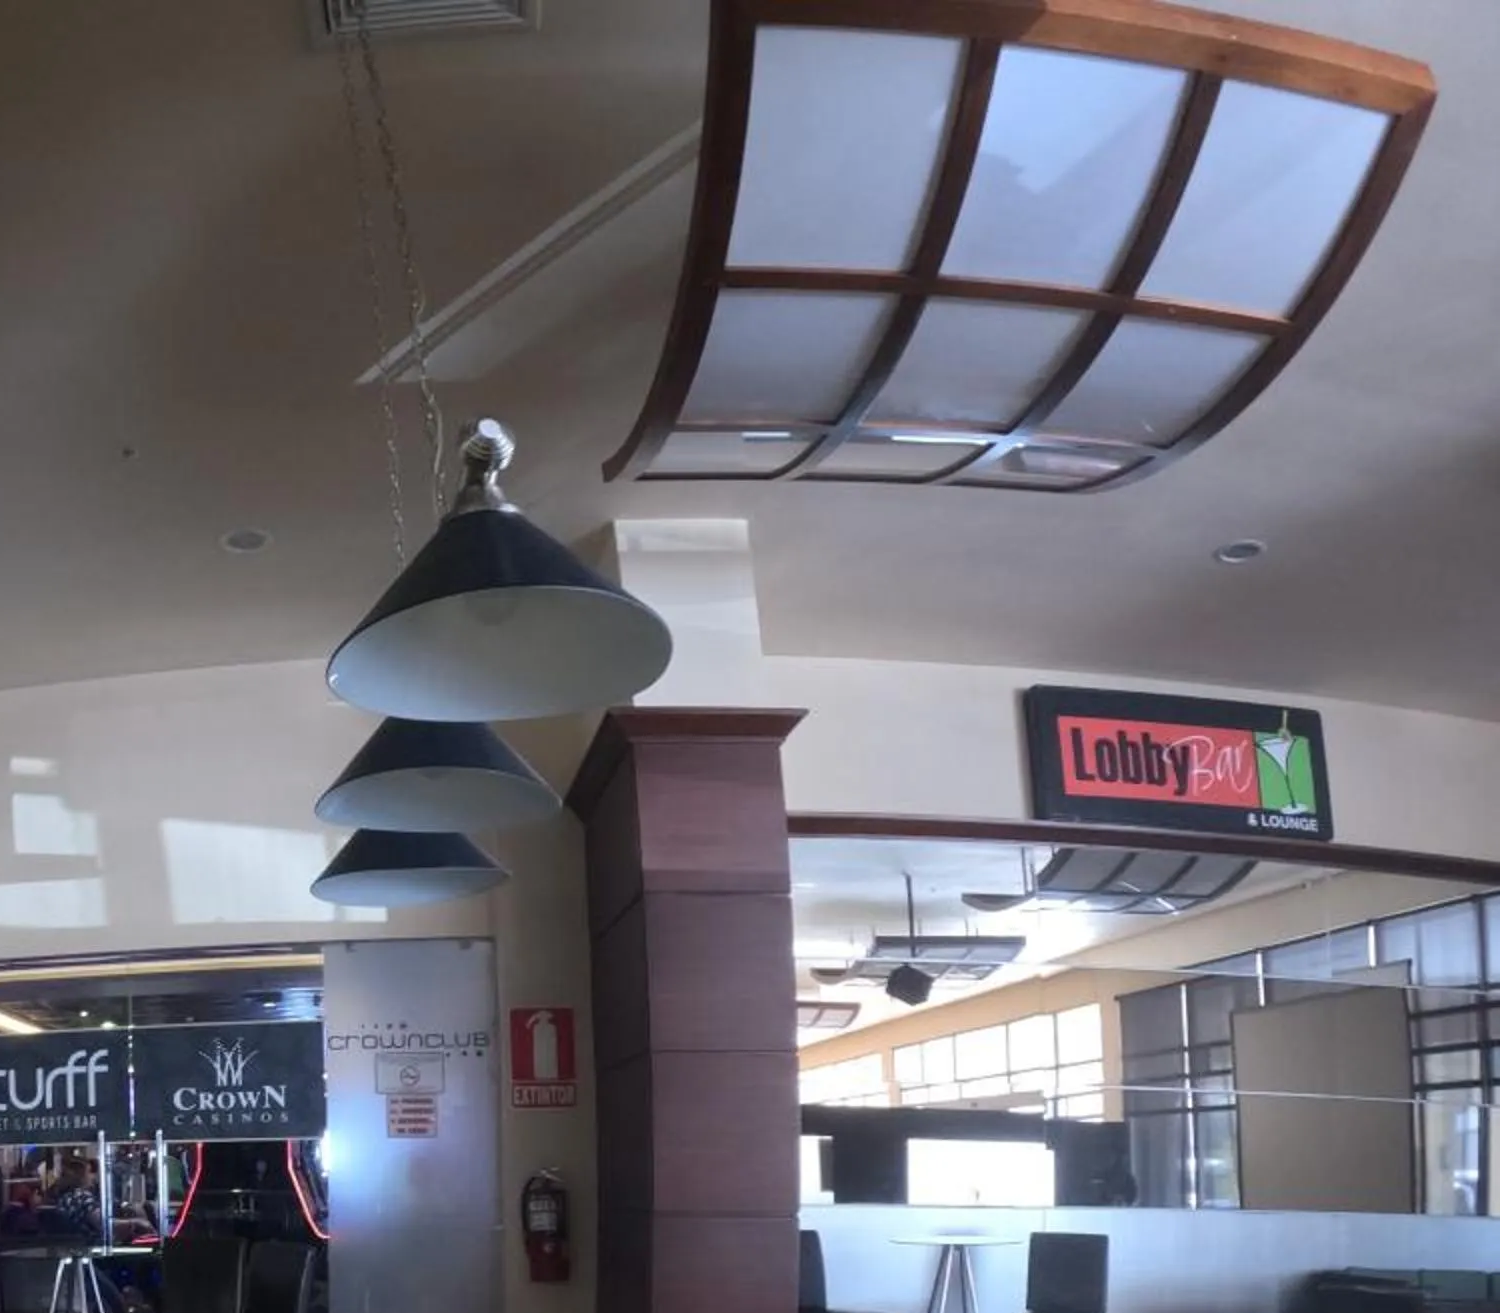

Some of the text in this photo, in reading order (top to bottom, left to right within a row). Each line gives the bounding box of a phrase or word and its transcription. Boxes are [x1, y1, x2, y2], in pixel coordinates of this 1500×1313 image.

[1071, 727, 1252, 796] Lobby Bar
[1247, 813, 1319, 832] & LOUNGE
[173, 1085, 287, 1111] CROWN
[26, 1115, 71, 1131] SPORTS
[73, 1114, 97, 1129] BAR
[173, 1111, 289, 1126] CASINOS
